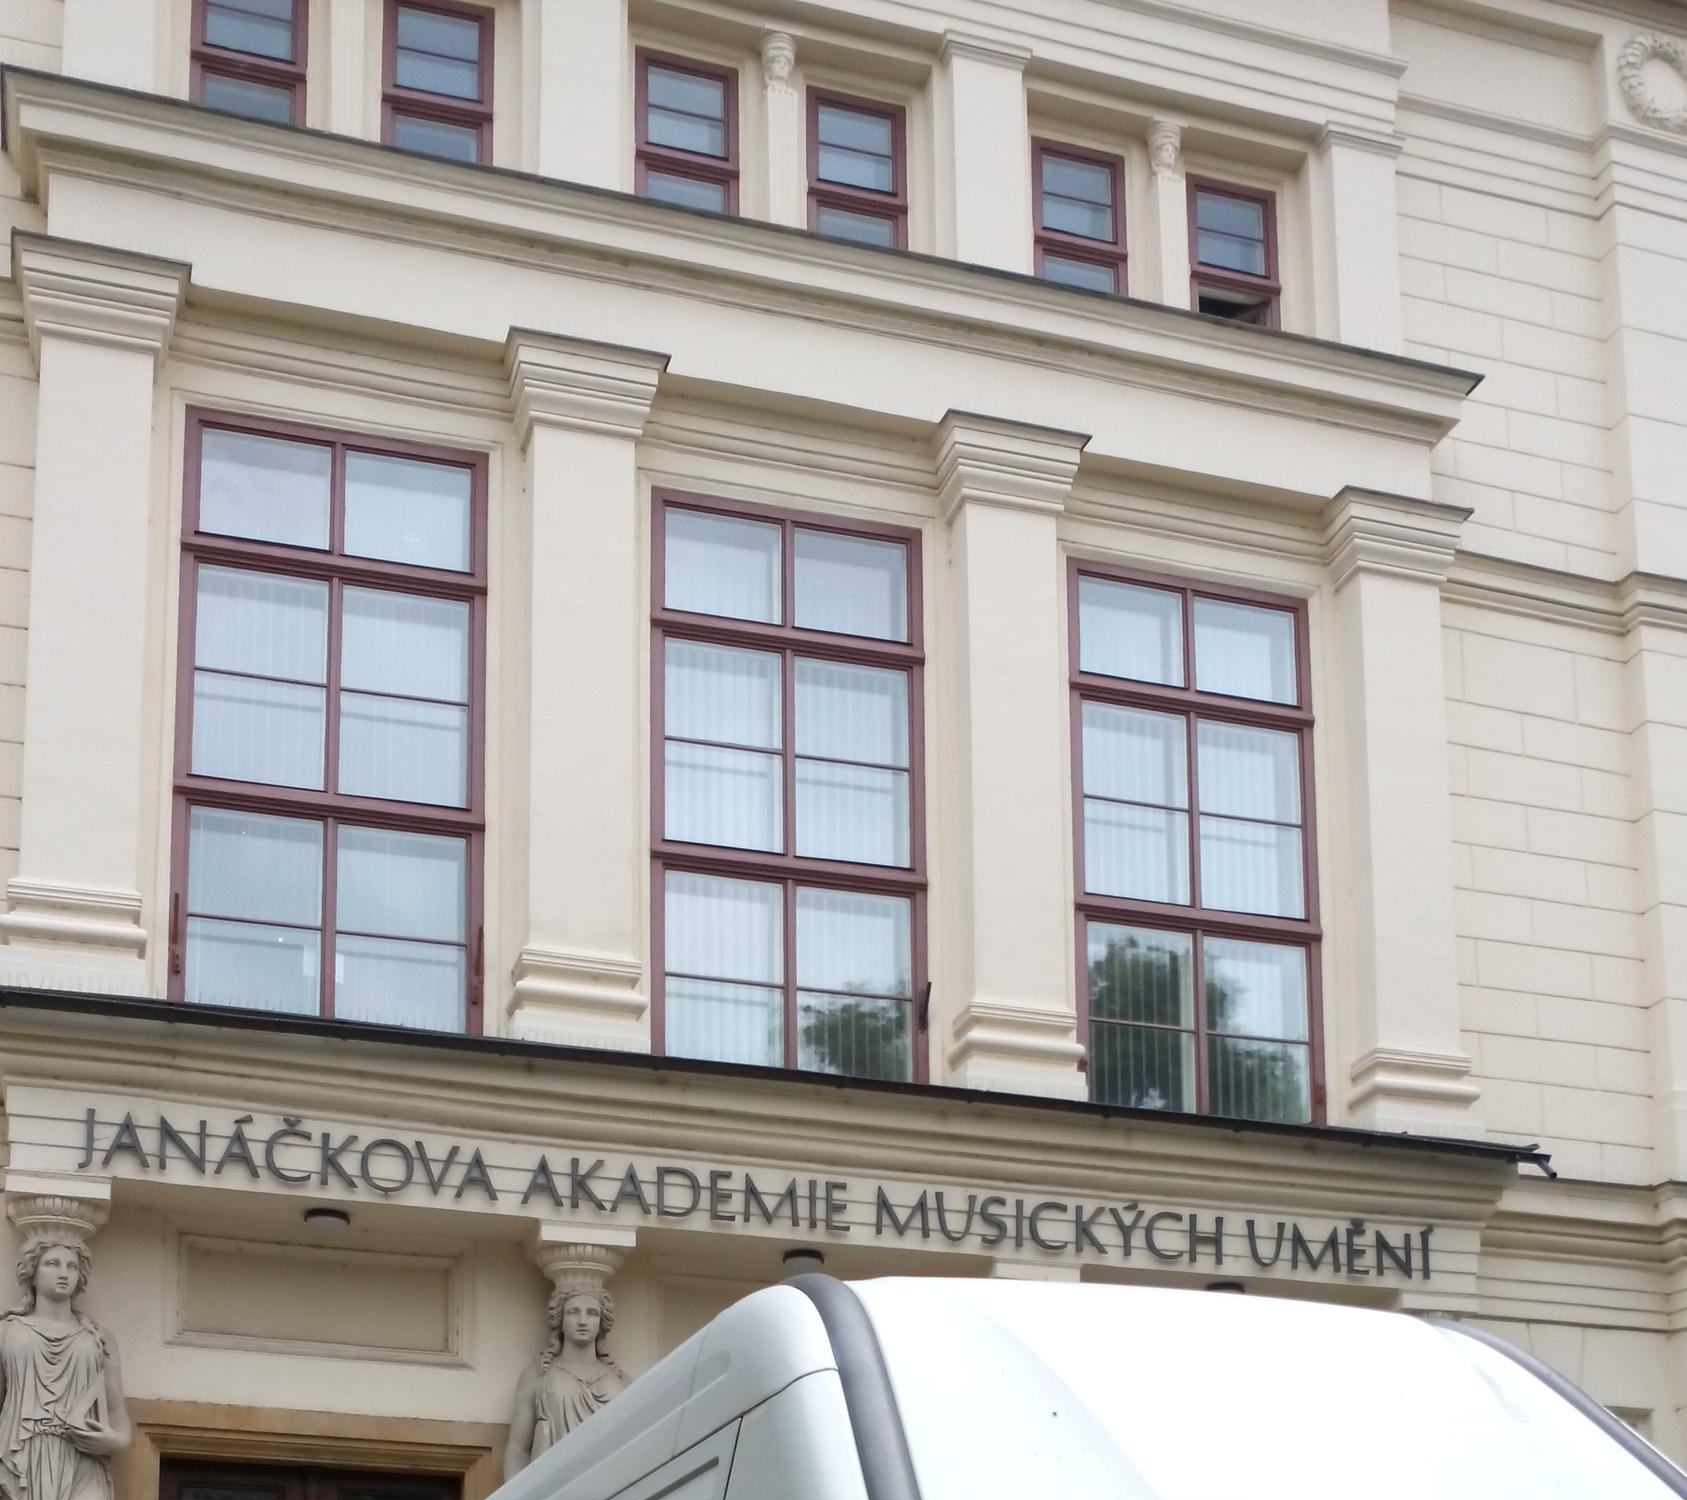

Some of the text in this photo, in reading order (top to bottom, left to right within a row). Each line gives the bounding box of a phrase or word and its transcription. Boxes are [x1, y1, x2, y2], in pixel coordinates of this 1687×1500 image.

[77, 1107, 1435, 1280] JANÁČKOVA AKADEMIE MUSICKÝCH UMĚNÍ
